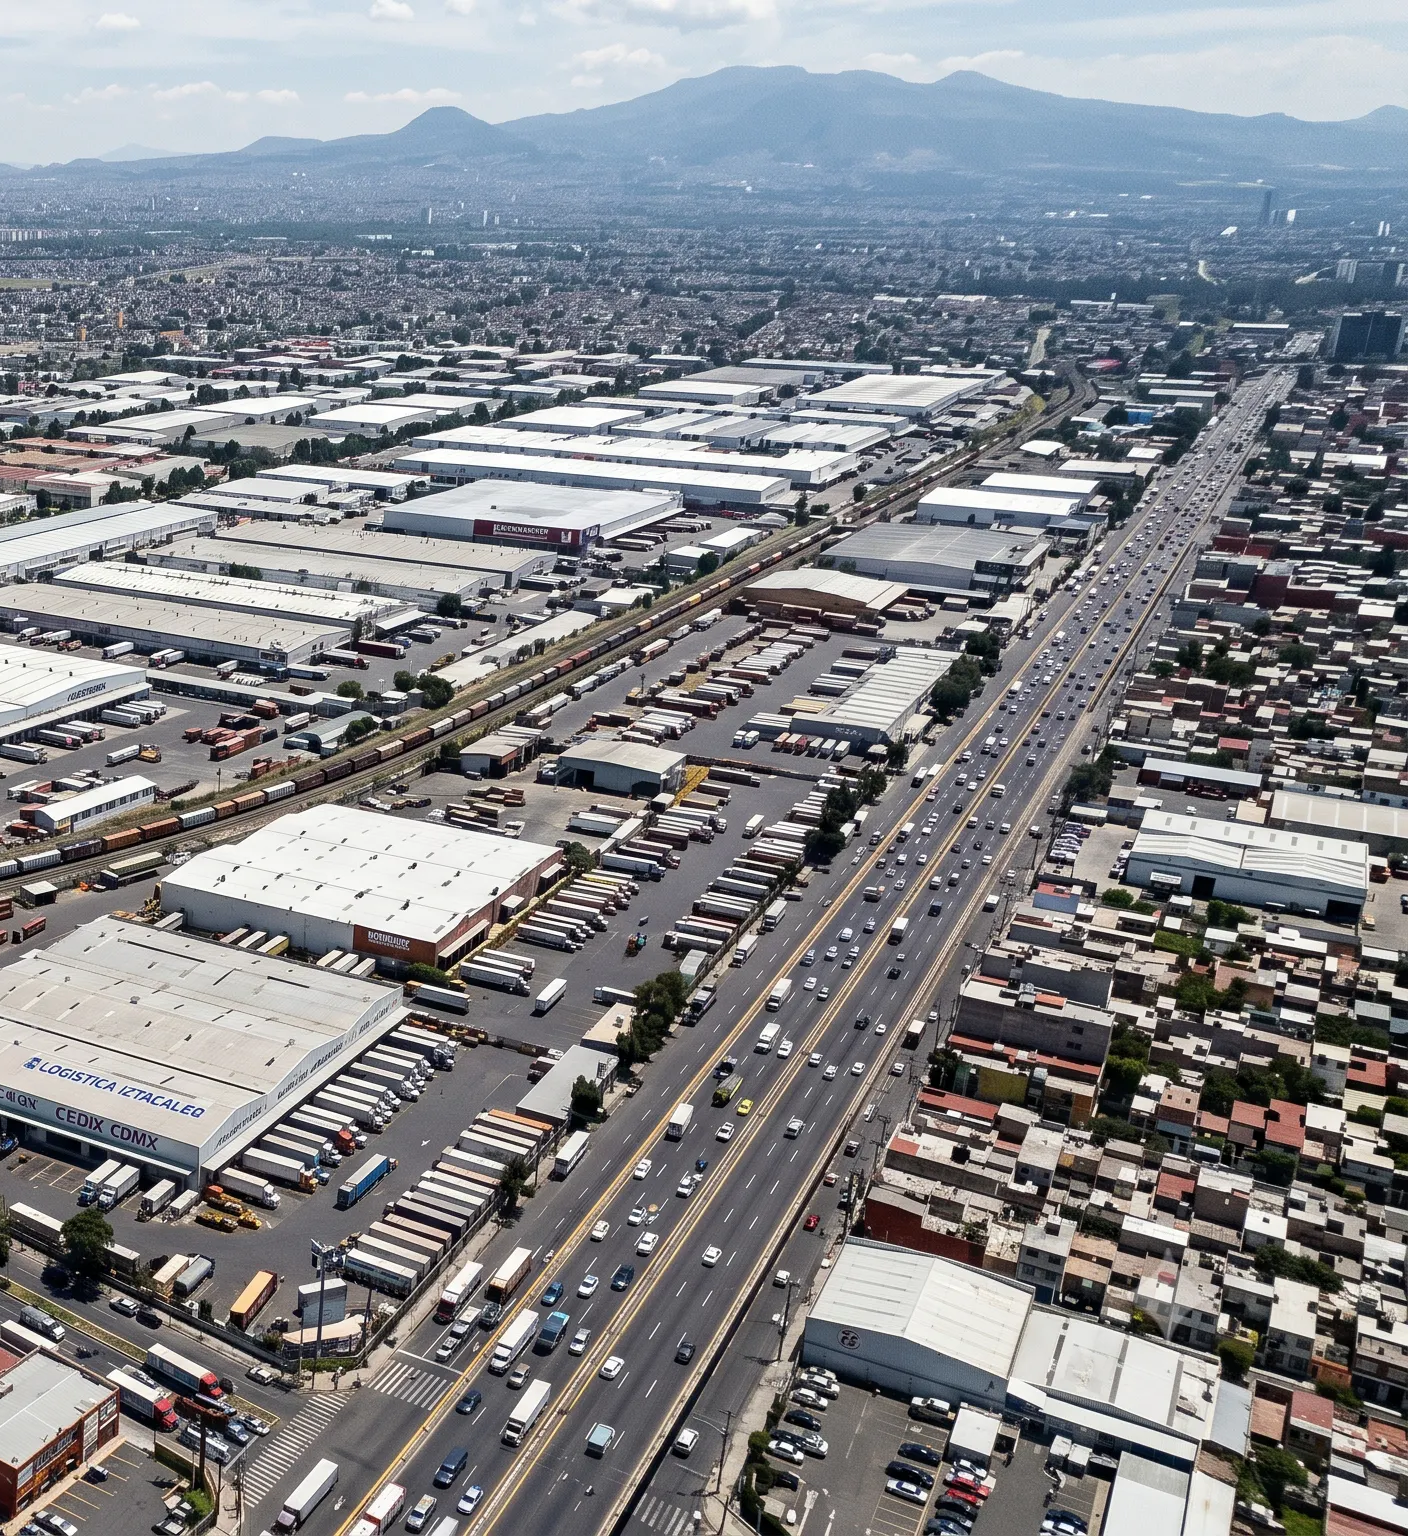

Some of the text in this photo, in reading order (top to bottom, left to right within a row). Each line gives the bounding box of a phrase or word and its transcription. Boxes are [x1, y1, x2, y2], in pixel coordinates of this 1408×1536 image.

[38, 1061, 117, 1093] LOGISTICA
[55, 1106, 159, 1151] CEDIX CDMX
